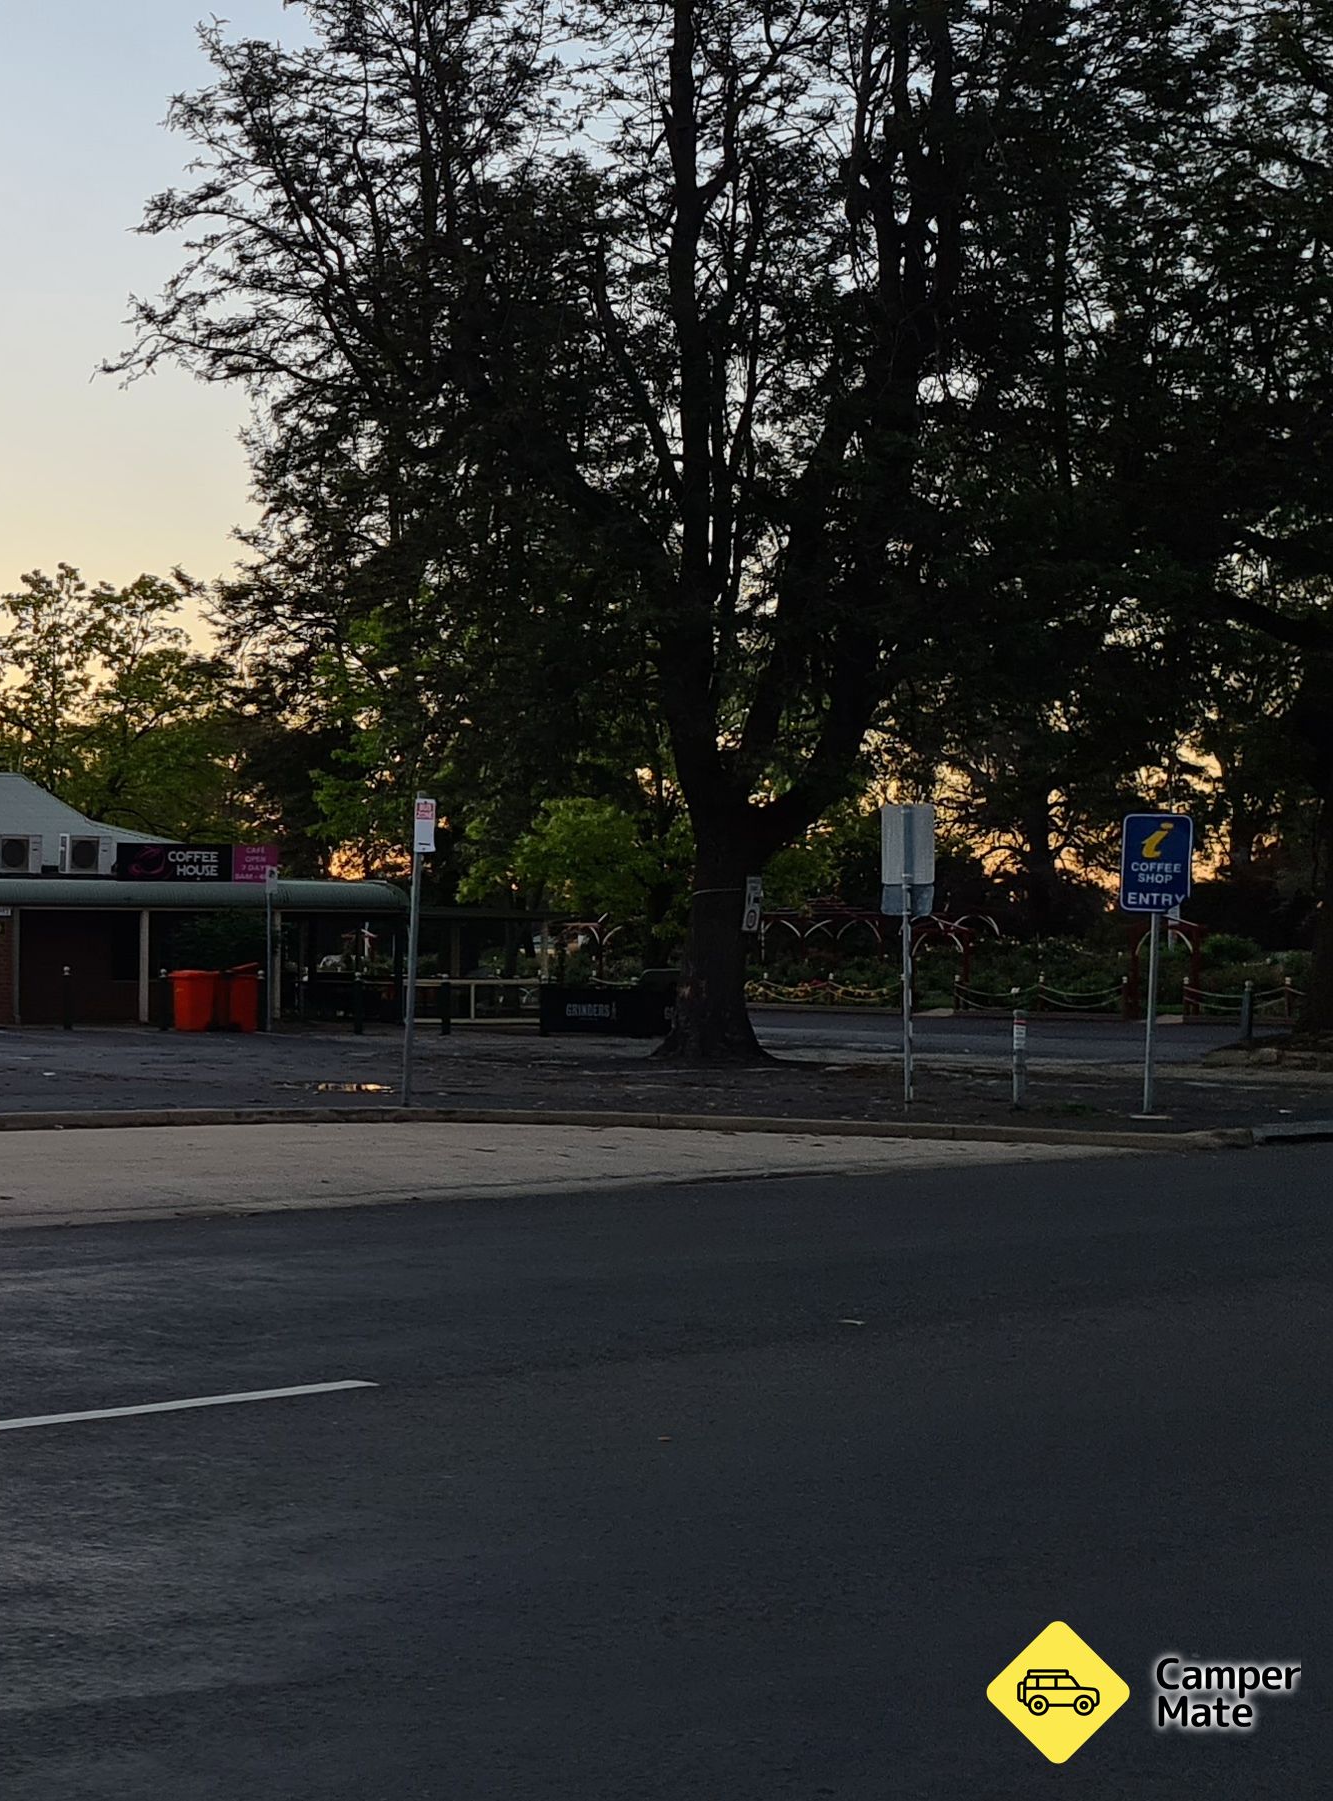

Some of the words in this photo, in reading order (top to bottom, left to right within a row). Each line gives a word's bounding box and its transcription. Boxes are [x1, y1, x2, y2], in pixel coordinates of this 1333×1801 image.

[167, 851, 219, 862] COFFEE
[176, 864, 219, 876] HOUSE
[1131, 862, 1182, 873] COFFEE
[1137, 873, 1174, 884] SHOP
[1127, 891, 1186, 906] ENTRY
[565, 1002, 611, 1018] GRINDERS
